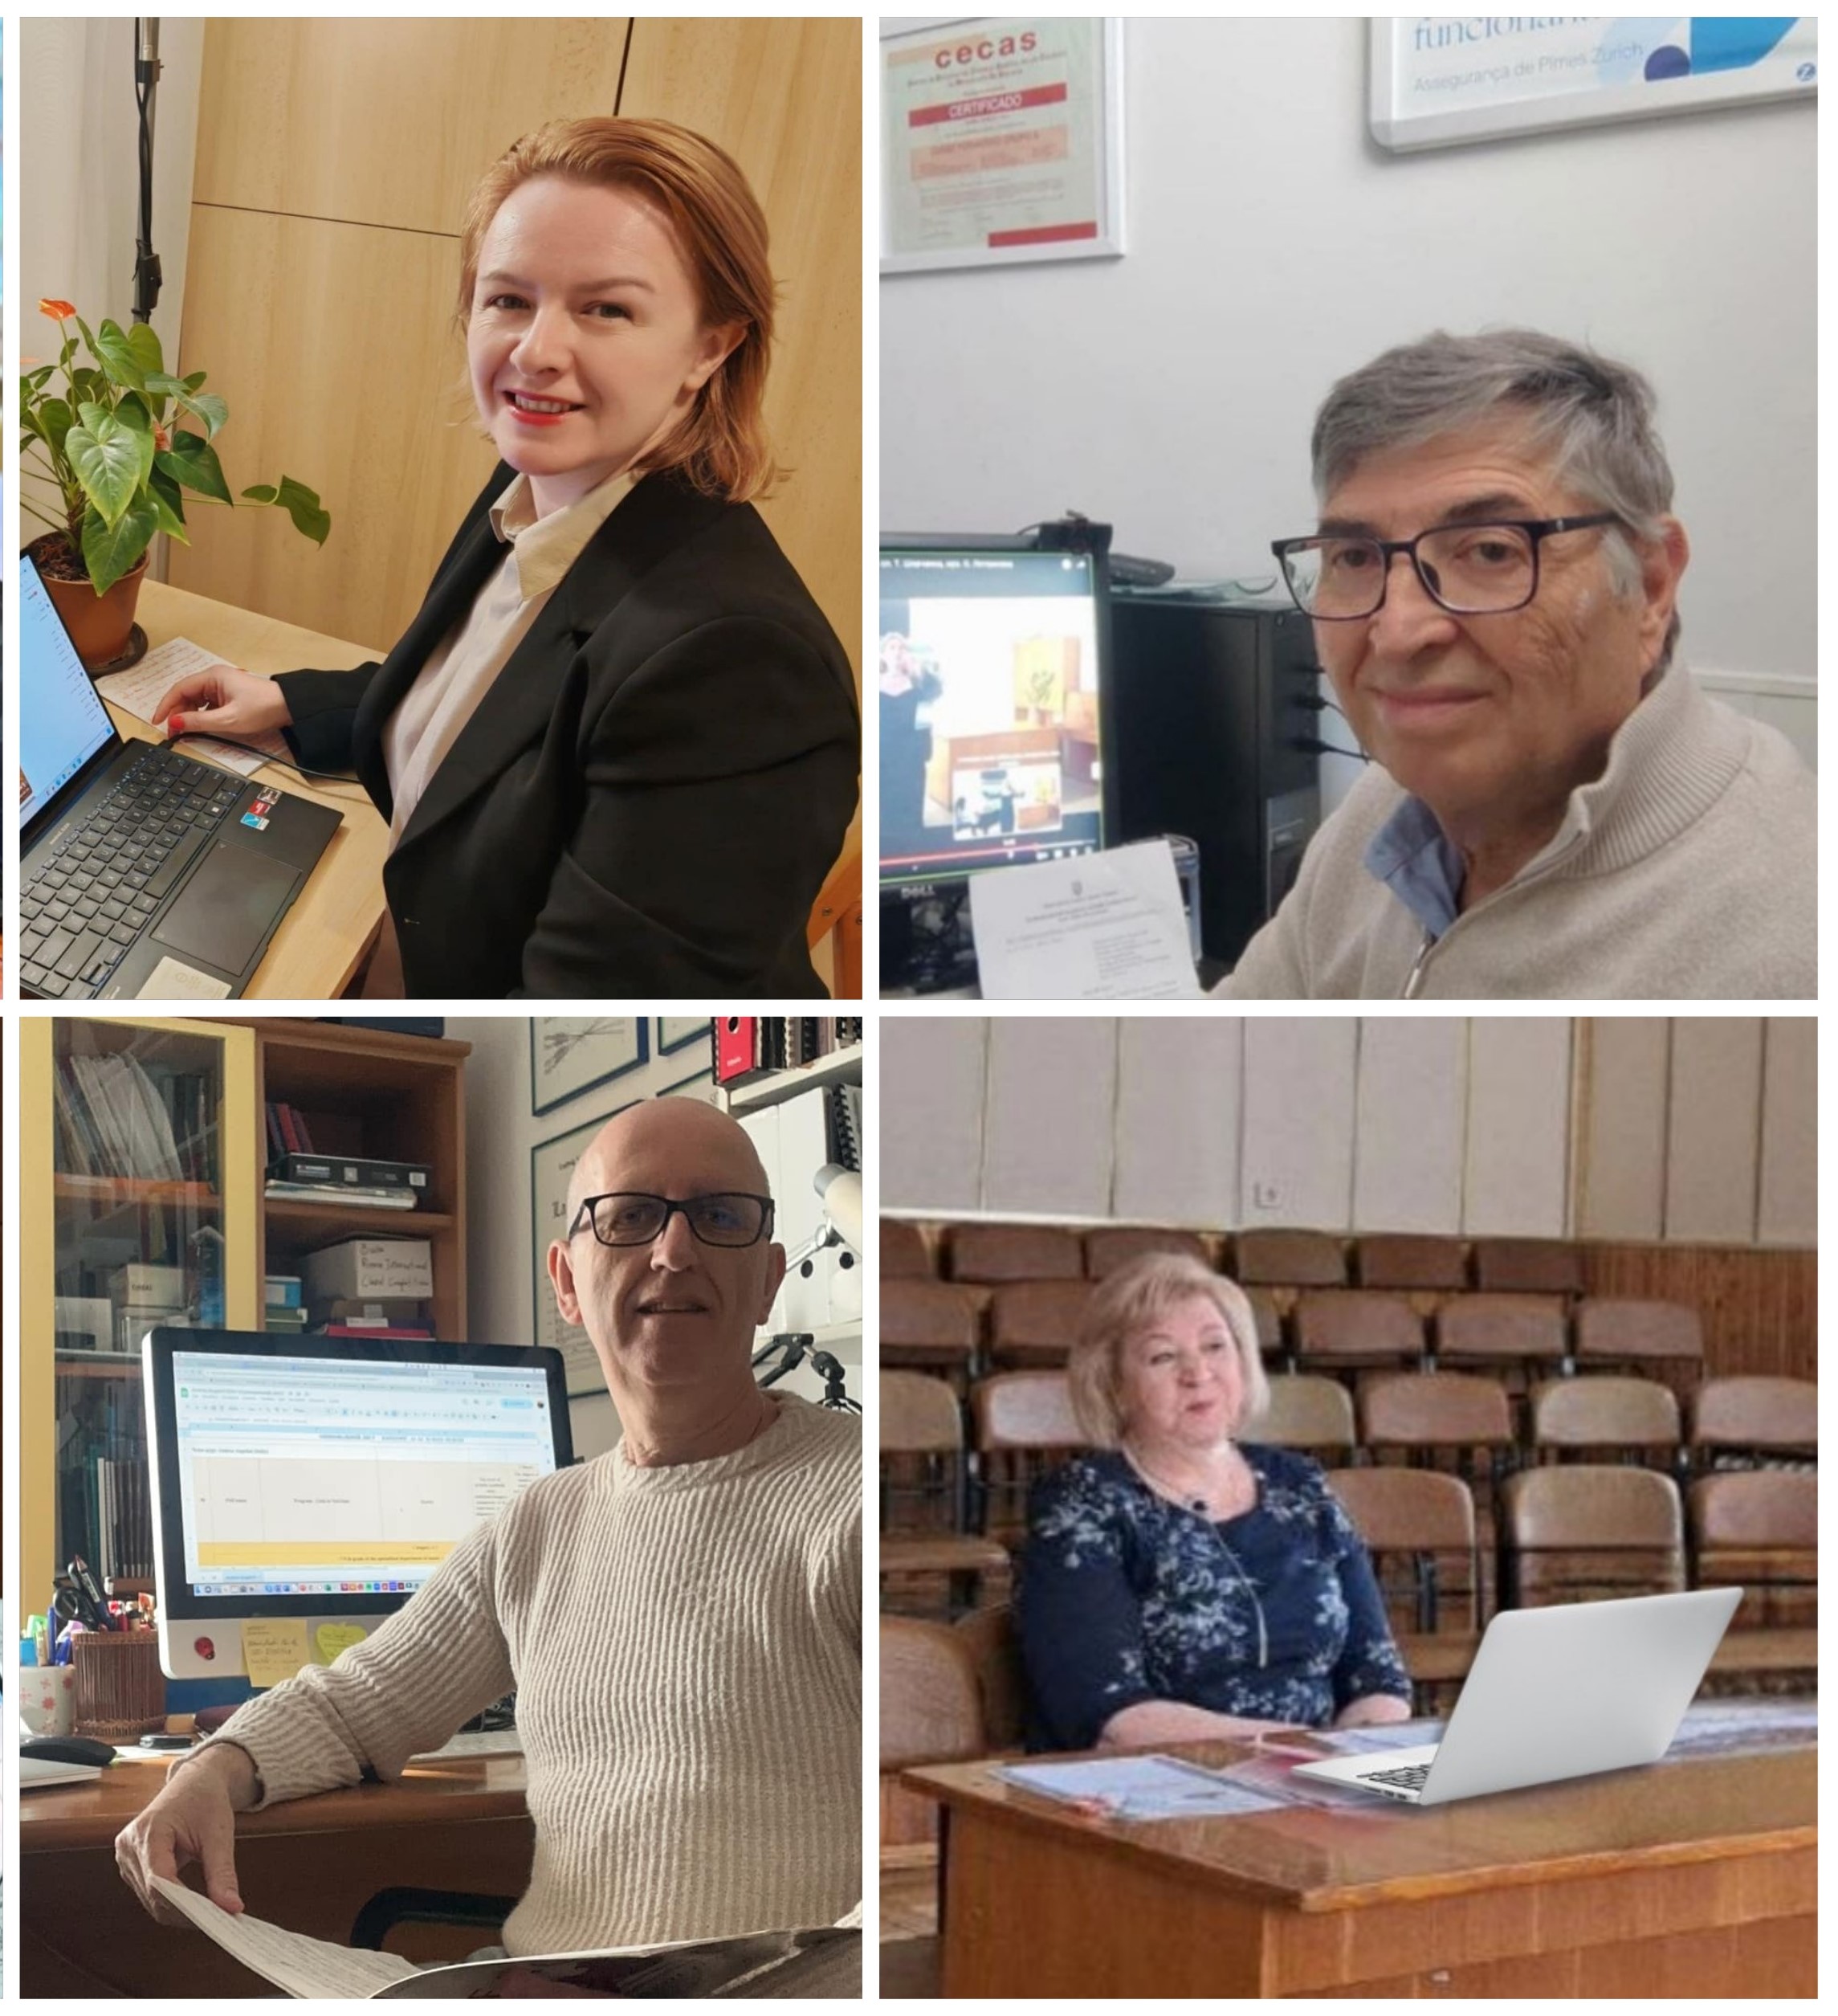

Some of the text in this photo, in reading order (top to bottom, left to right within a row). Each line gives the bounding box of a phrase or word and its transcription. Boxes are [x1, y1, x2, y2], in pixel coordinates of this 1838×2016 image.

[935, 31, 1037, 68] cecas
[1514, 61, 1535, 77] de
[948, 94, 1022, 119] CERTIFICADO
